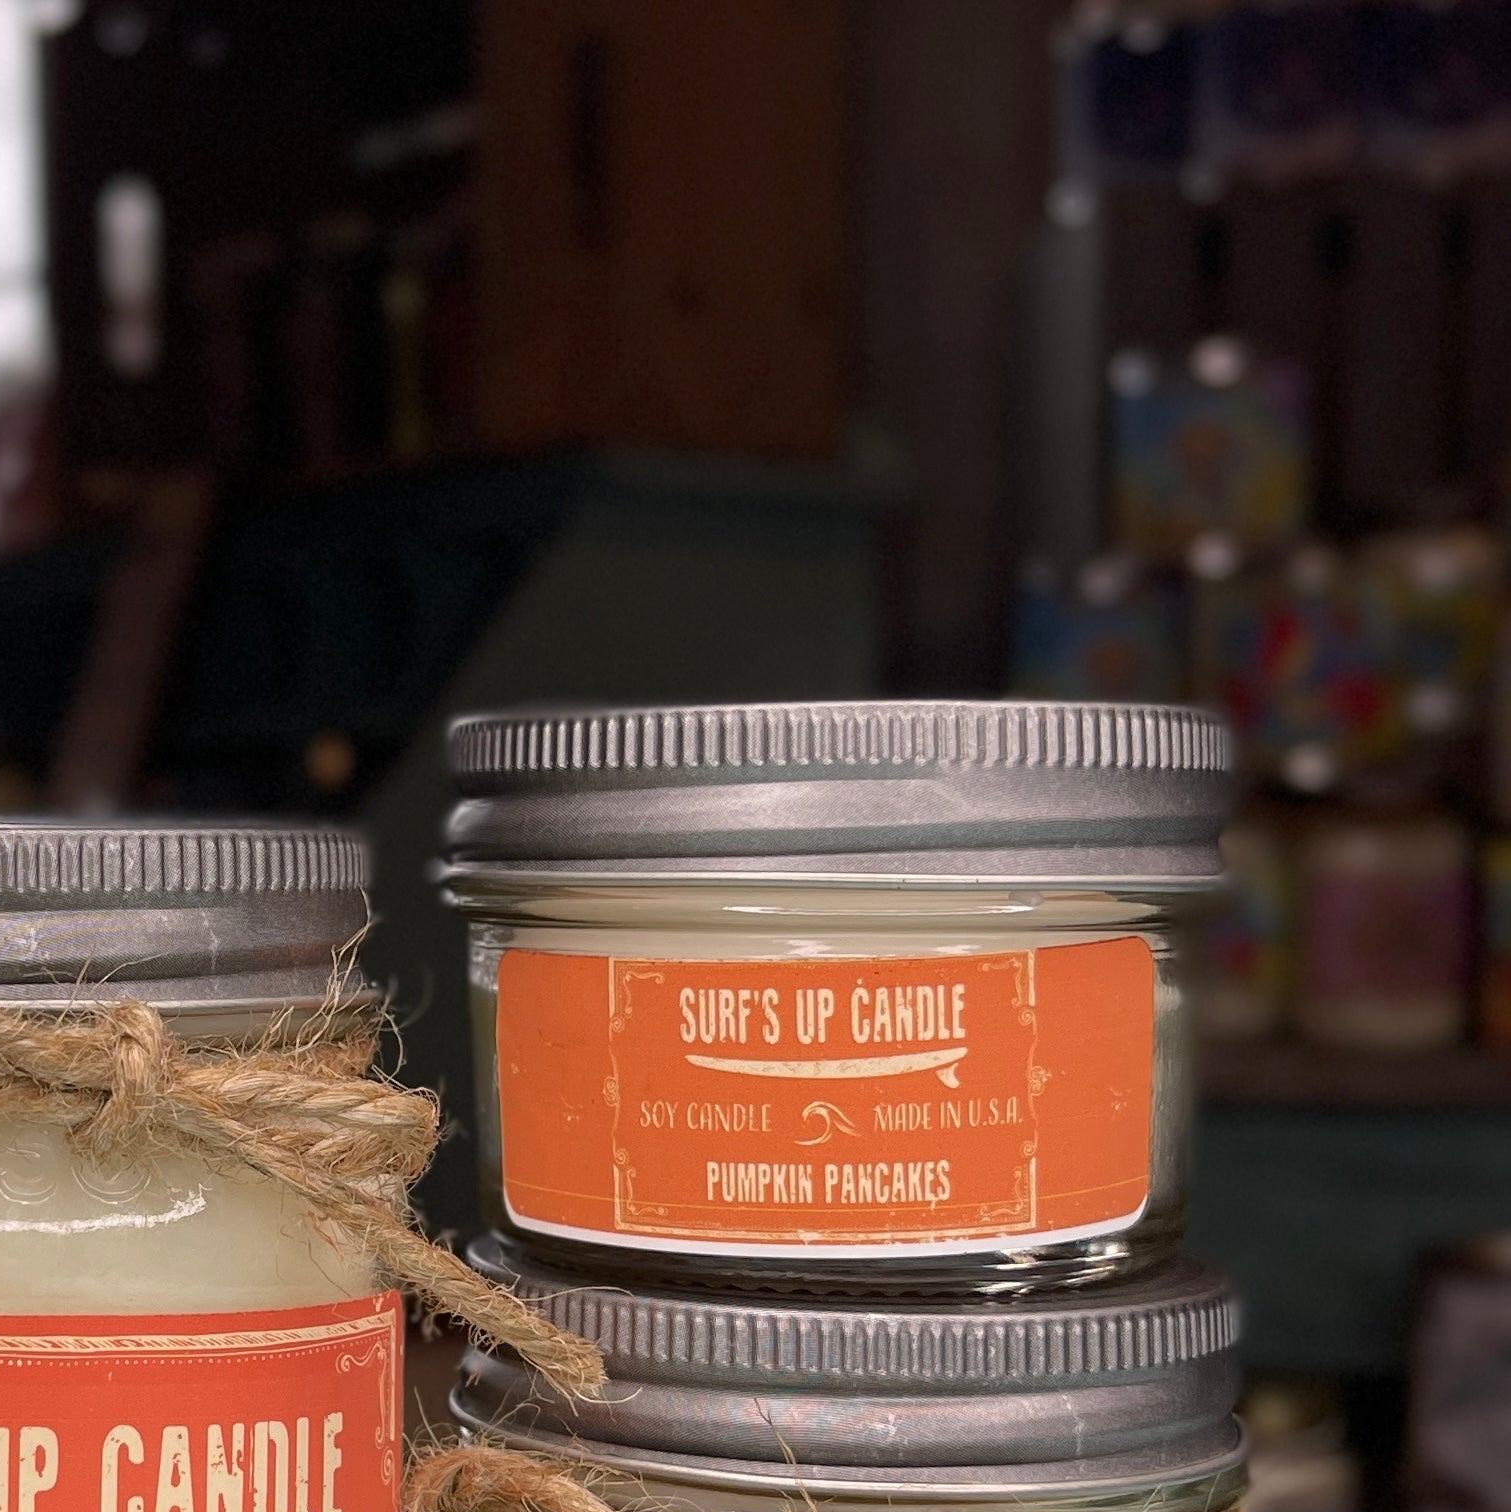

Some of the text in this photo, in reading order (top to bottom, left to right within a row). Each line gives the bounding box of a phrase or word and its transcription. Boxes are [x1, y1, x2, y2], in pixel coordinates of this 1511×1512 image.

[679, 985, 966, 1045] SURF'S UP CANDLE
[640, 1100, 771, 1133] SOY CANDLE
[873, 1096, 1024, 1132] MADE IN U.S.A.
[706, 1159, 951, 1205] PUMPKIN PANCAKES
